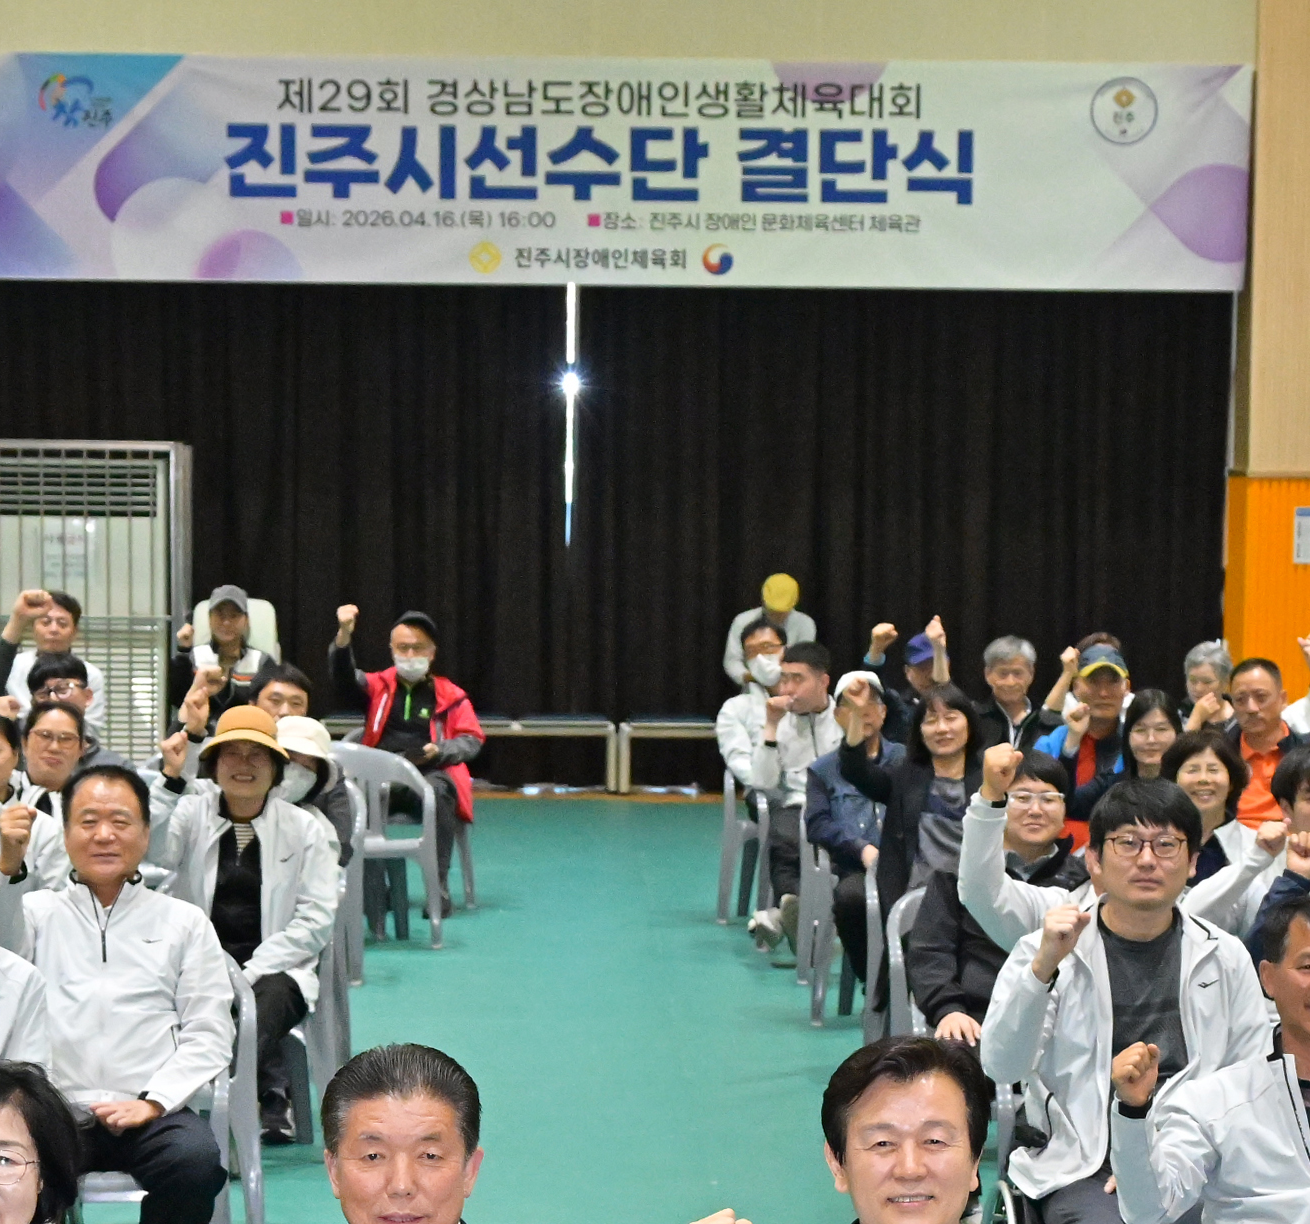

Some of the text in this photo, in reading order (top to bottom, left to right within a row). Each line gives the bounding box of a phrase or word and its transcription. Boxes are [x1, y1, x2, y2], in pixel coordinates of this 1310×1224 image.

[277, 77, 923, 120] 제29회 경상남도장애인생활체육대회
[225, 122, 975, 206] 진주시선수단 결단식
[296, 209, 336, 228] 일시:
[499, 211, 557, 229] 16:00
[603, 212, 922, 234] 장소: 진주시 장애인 문화체육센터 체육관
[514, 246, 687, 269] 진주시장애인체육회
